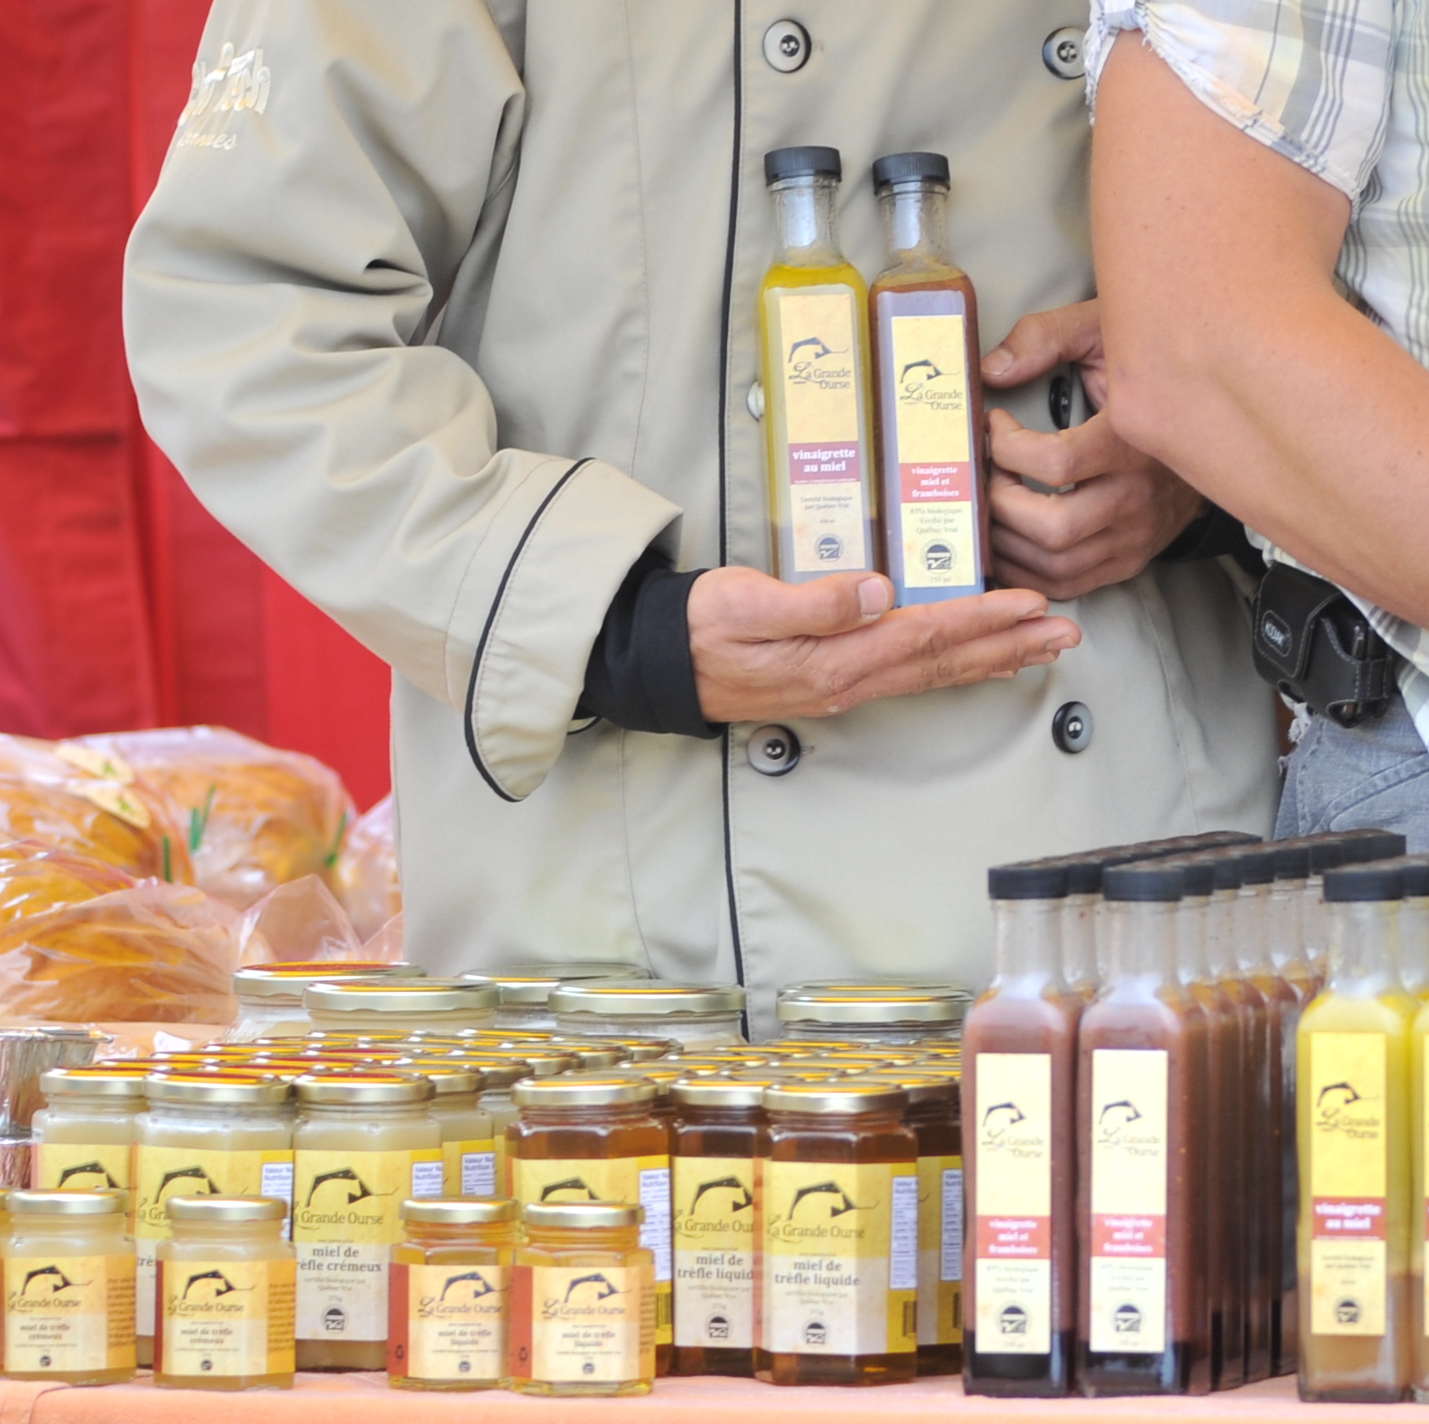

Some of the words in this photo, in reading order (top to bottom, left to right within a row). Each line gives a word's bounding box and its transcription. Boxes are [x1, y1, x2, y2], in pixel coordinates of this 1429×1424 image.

[813, 367, 851, 379] Grande
[820, 379, 851, 390] Ourse
[925, 389, 963, 400] Grande
[931, 401, 962, 411] Ourse
[793, 448, 856, 462] vinaigrette
[803, 463, 819, 473] au
[820, 460, 846, 473] miel
[911, 466, 958, 477] vinaigrette
[920, 478, 939, 487] miel
[941, 478, 950, 486] et
[912, 488, 960, 498] framboises
[1315, 1203, 1382, 1217] vinaigrette
[301, 1210, 345, 1225] Grande
[348, 1212, 384, 1225] Ourse
[1343, 1217, 1371, 1229] miel
[685, 1218, 730, 1232] Grande
[783, 1225, 827, 1238] Grande
[830, 1226, 865, 1239] Ourse
[312, 1245, 341, 1257] miel
[344, 1246, 360, 1257] de
[696, 1254, 724, 1266] miel
[728, 1254, 744, 1266] de
[794, 1260, 823, 1271] miel
[826, 1259, 842, 1271] de
[327, 1260, 382, 1272] crémeux
[677, 1267, 712, 1280] trèfle
[716, 1267, 754, 1282] liquid
[775, 1272, 810, 1285] trèfle
[813, 1274, 860, 1288] liquide
[18, 1298, 51, 1308] Grande
[53, 1298, 81, 1308] Ourse
[179, 1302, 214, 1312] Grande
[216, 1303, 244, 1312] Ourse
[436, 1303, 472, 1314] Grande
[560, 1305, 596, 1315] Grande
[599, 1305, 626, 1315] Ourse
[20, 1324, 38, 1332] miel
[180, 1328, 199, 1336] miel
[200, 1328, 210, 1336] de
[438, 1329, 456, 1337] miel
[459, 1329, 468, 1337] de
[562, 1331, 580, 1339] miel
[583, 1330, 592, 1339] de
